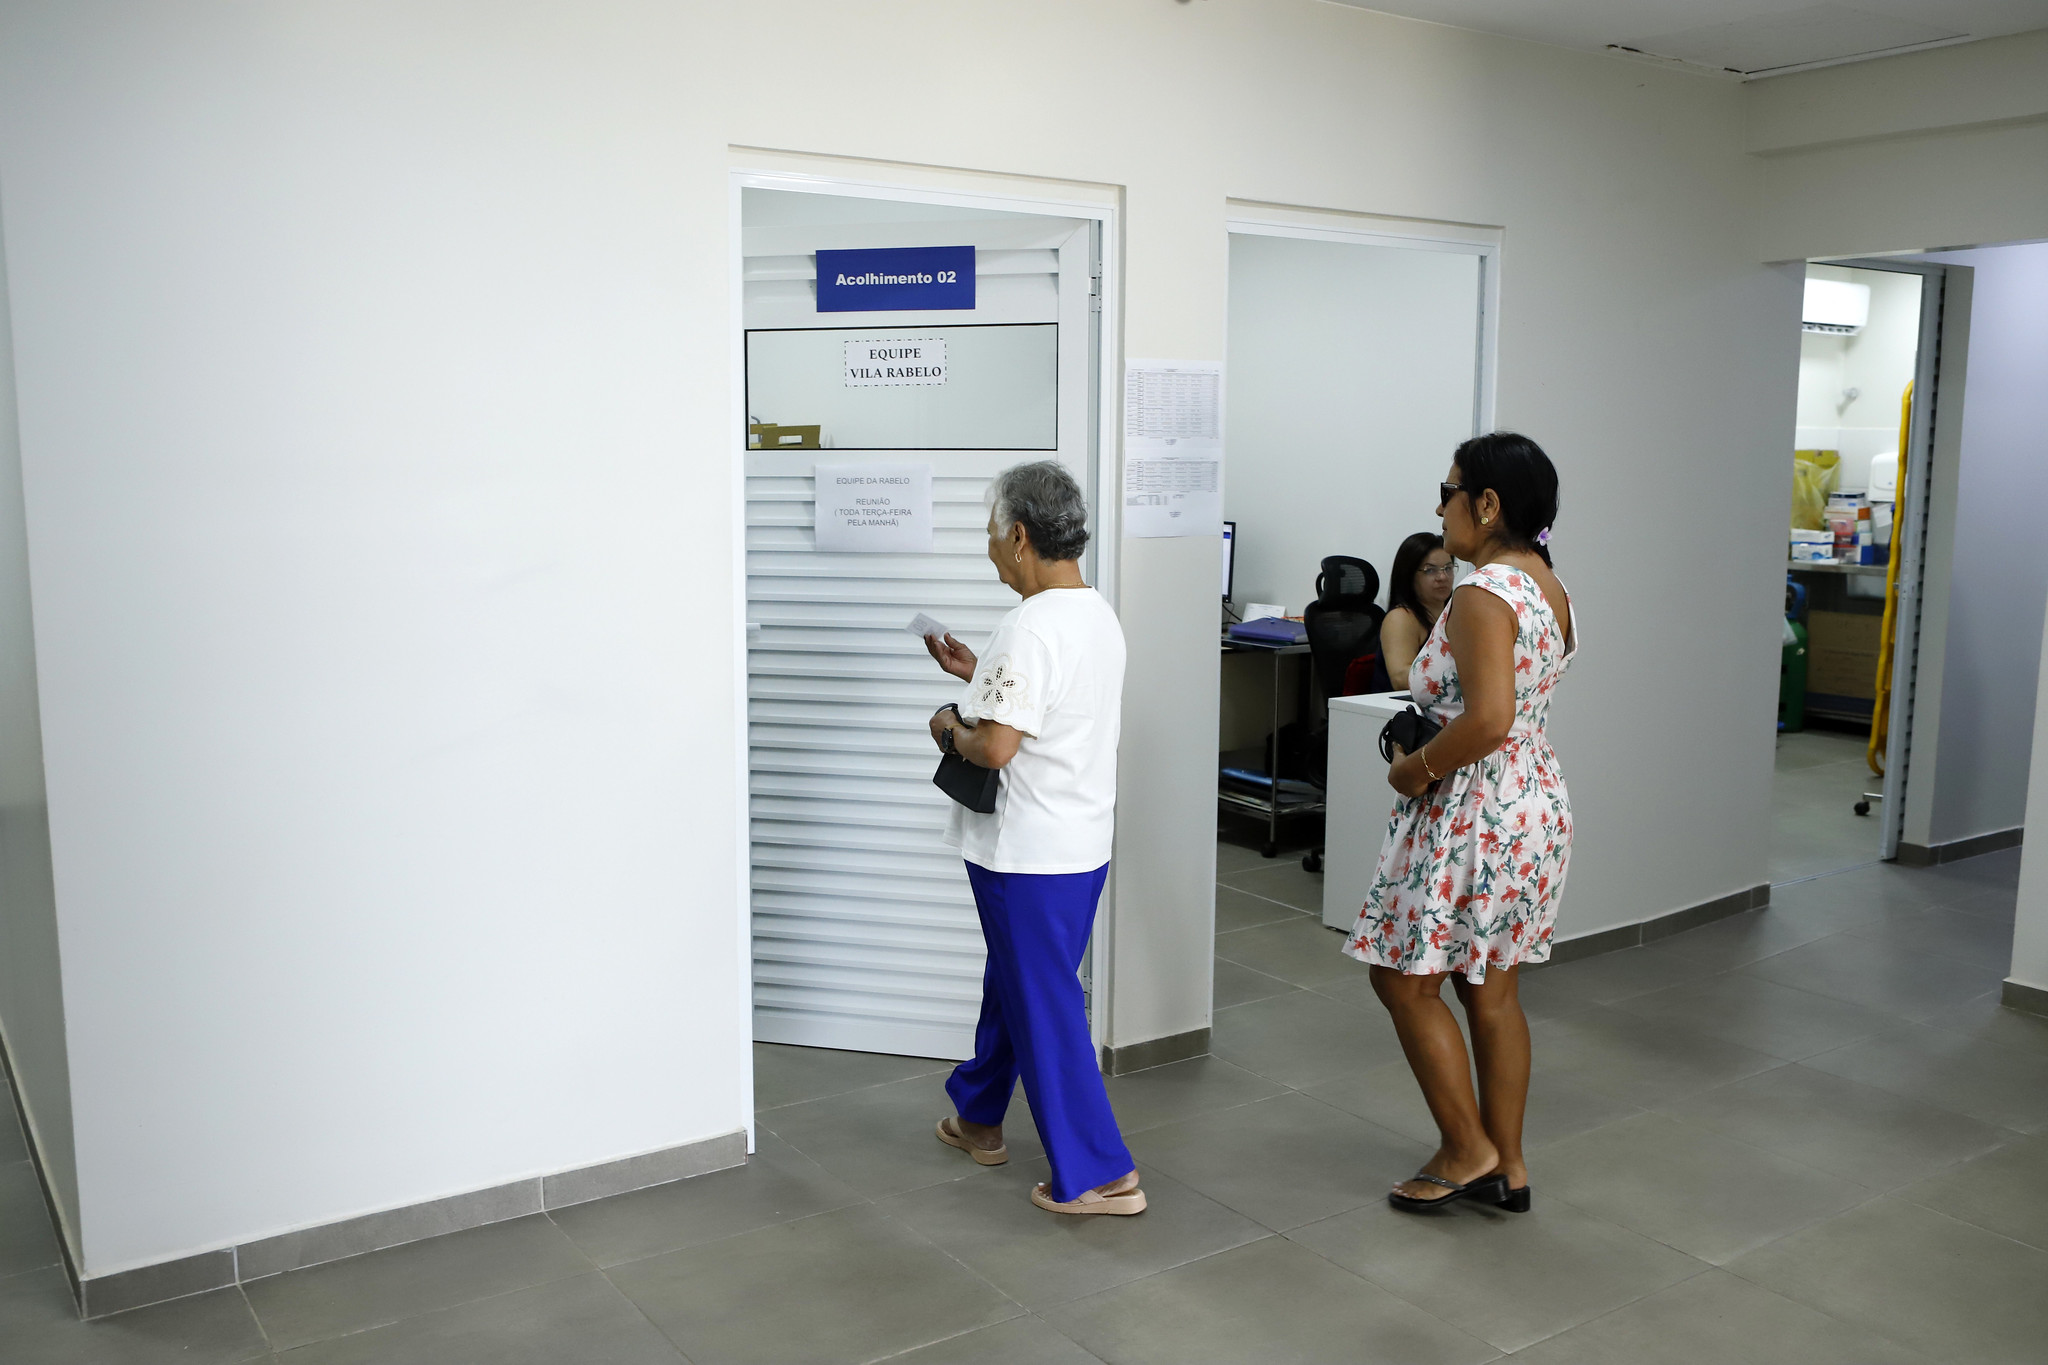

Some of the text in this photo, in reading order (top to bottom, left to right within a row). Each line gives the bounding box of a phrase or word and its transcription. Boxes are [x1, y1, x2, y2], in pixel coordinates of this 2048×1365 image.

[836, 271, 956, 286] Acolhimento 02
[869, 348, 921, 361] EQUIPE
[850, 367, 942, 378] VILA RABELO
[866, 477, 877, 485] DA
[879, 477, 910, 485] RABELO
[856, 497, 890, 505] REUNIÃO
[862, 509, 912, 517] TERÇA-FEIRA
[848, 518, 898, 527] PELA MANHÃ)
